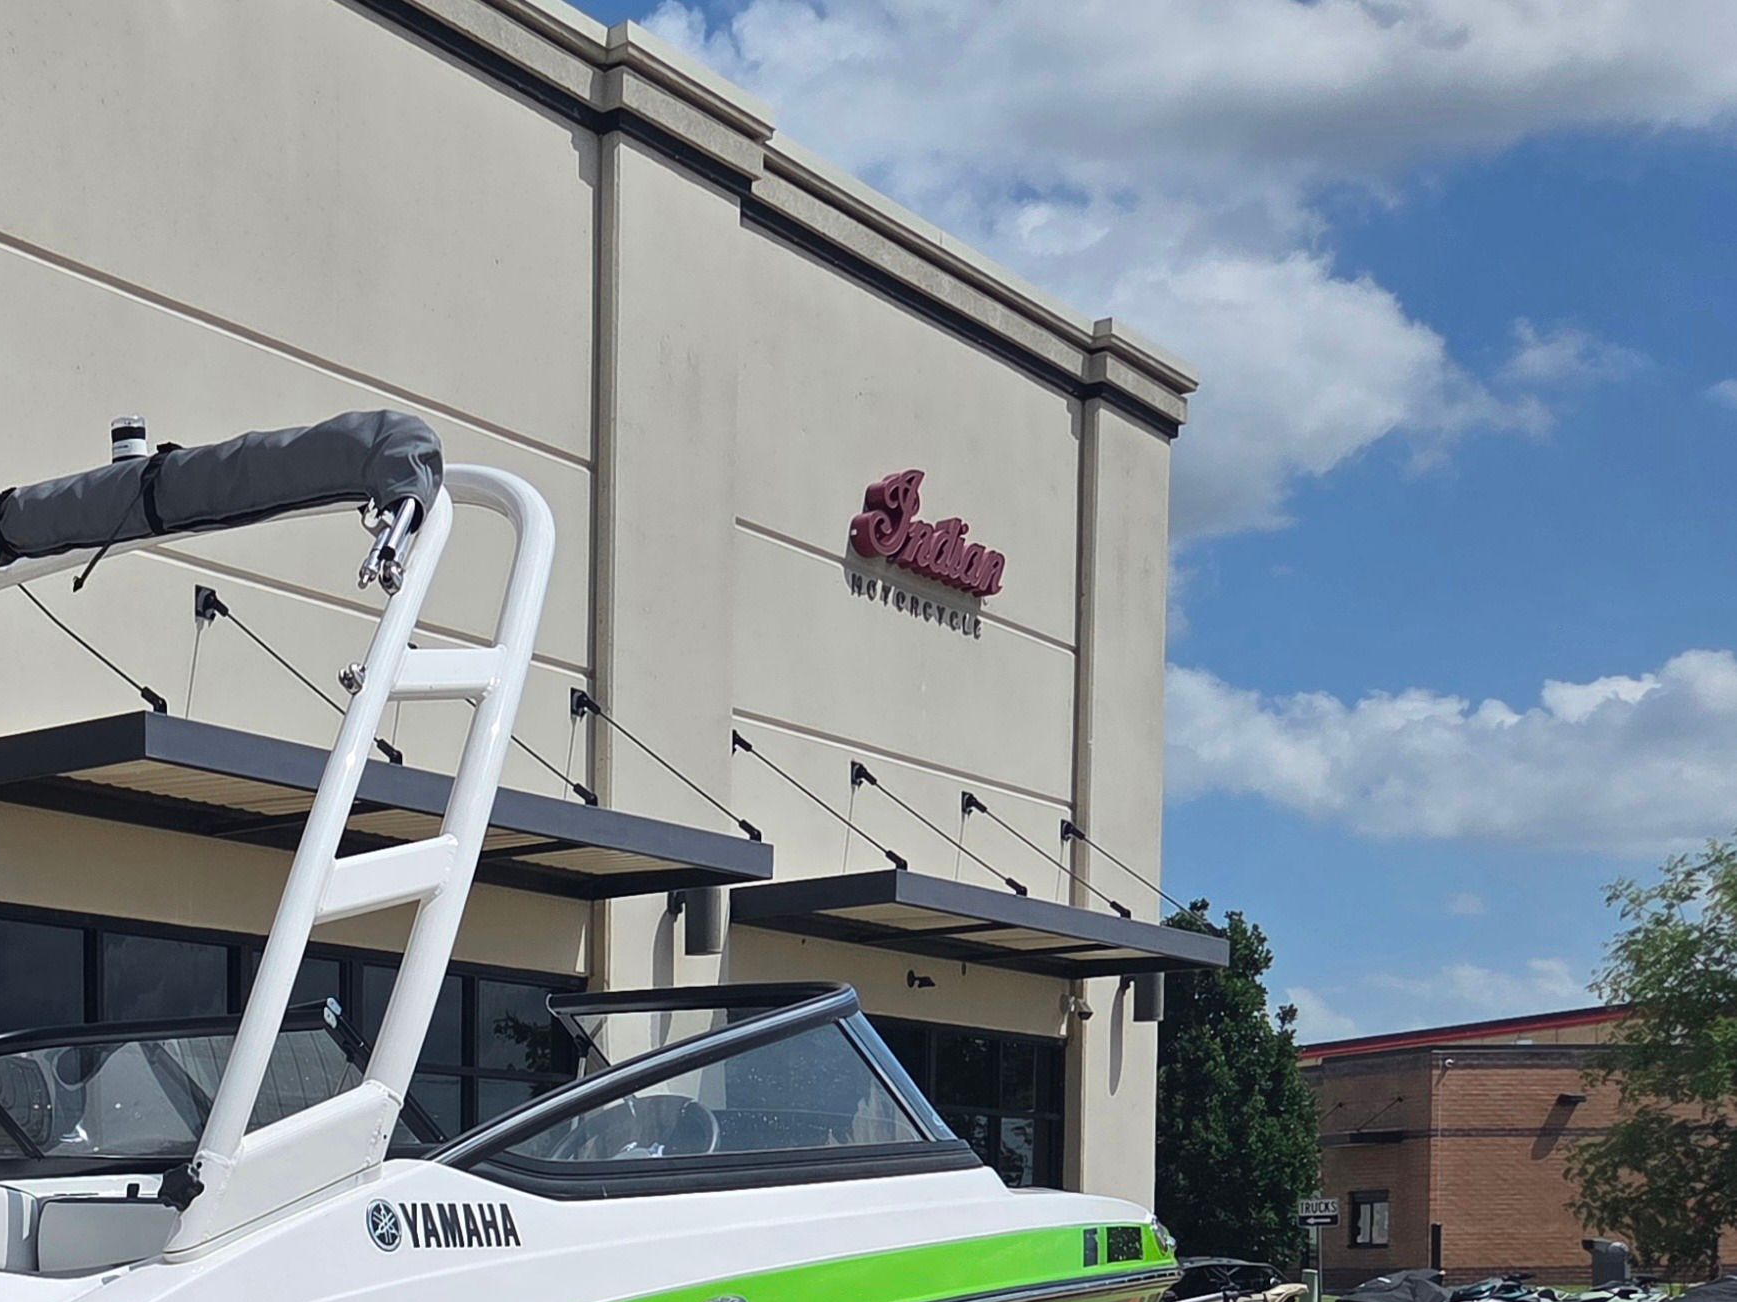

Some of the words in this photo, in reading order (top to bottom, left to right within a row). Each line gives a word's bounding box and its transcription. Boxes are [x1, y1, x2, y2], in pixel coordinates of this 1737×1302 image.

[849, 469, 1005, 597] Indian
[850, 573, 982, 640] MOTORCYCLE
[399, 1203, 521, 1248] YAMAHA
[1300, 1201, 1337, 1213] TRUCKS
